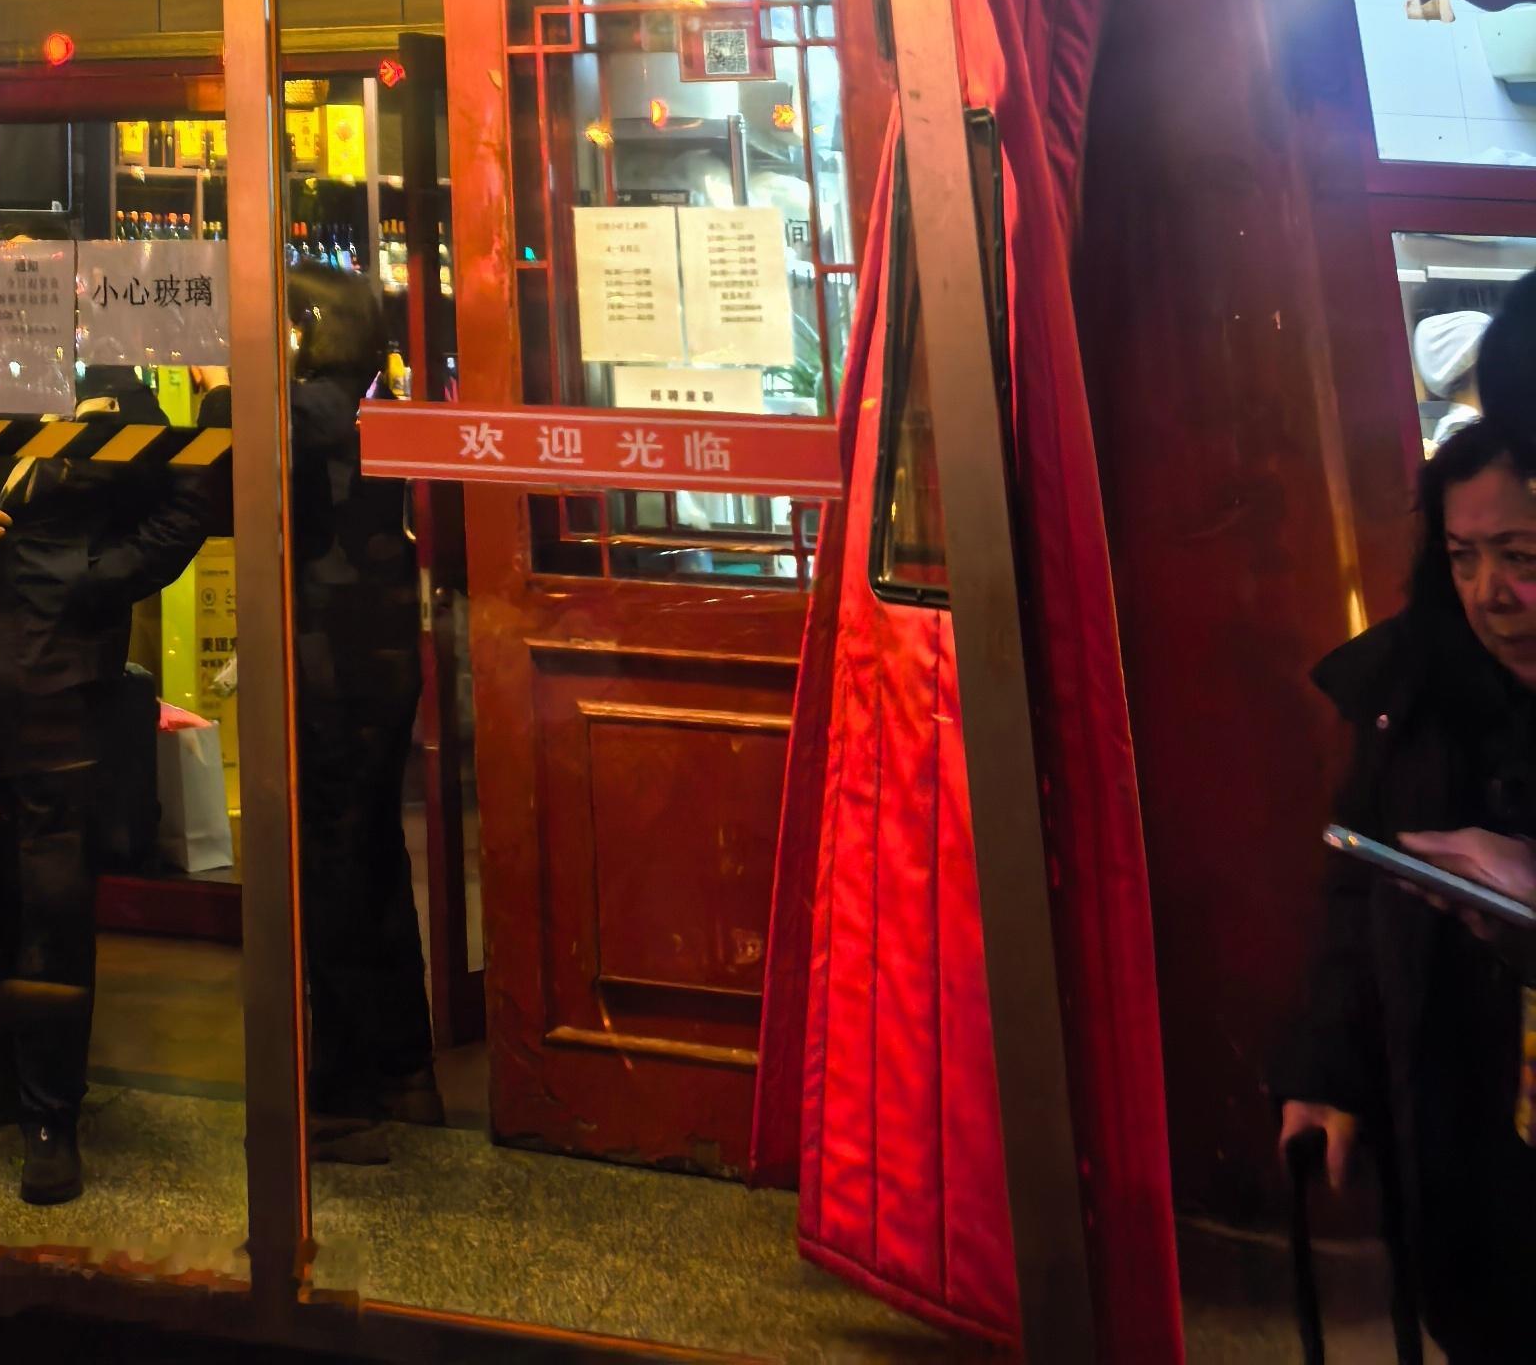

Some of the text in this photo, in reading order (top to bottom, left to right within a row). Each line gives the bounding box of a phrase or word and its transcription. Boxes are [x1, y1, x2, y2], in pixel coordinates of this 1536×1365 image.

[91, 274, 213, 308] 小心玻璃
[459, 422, 732, 472] 欢迎光临
